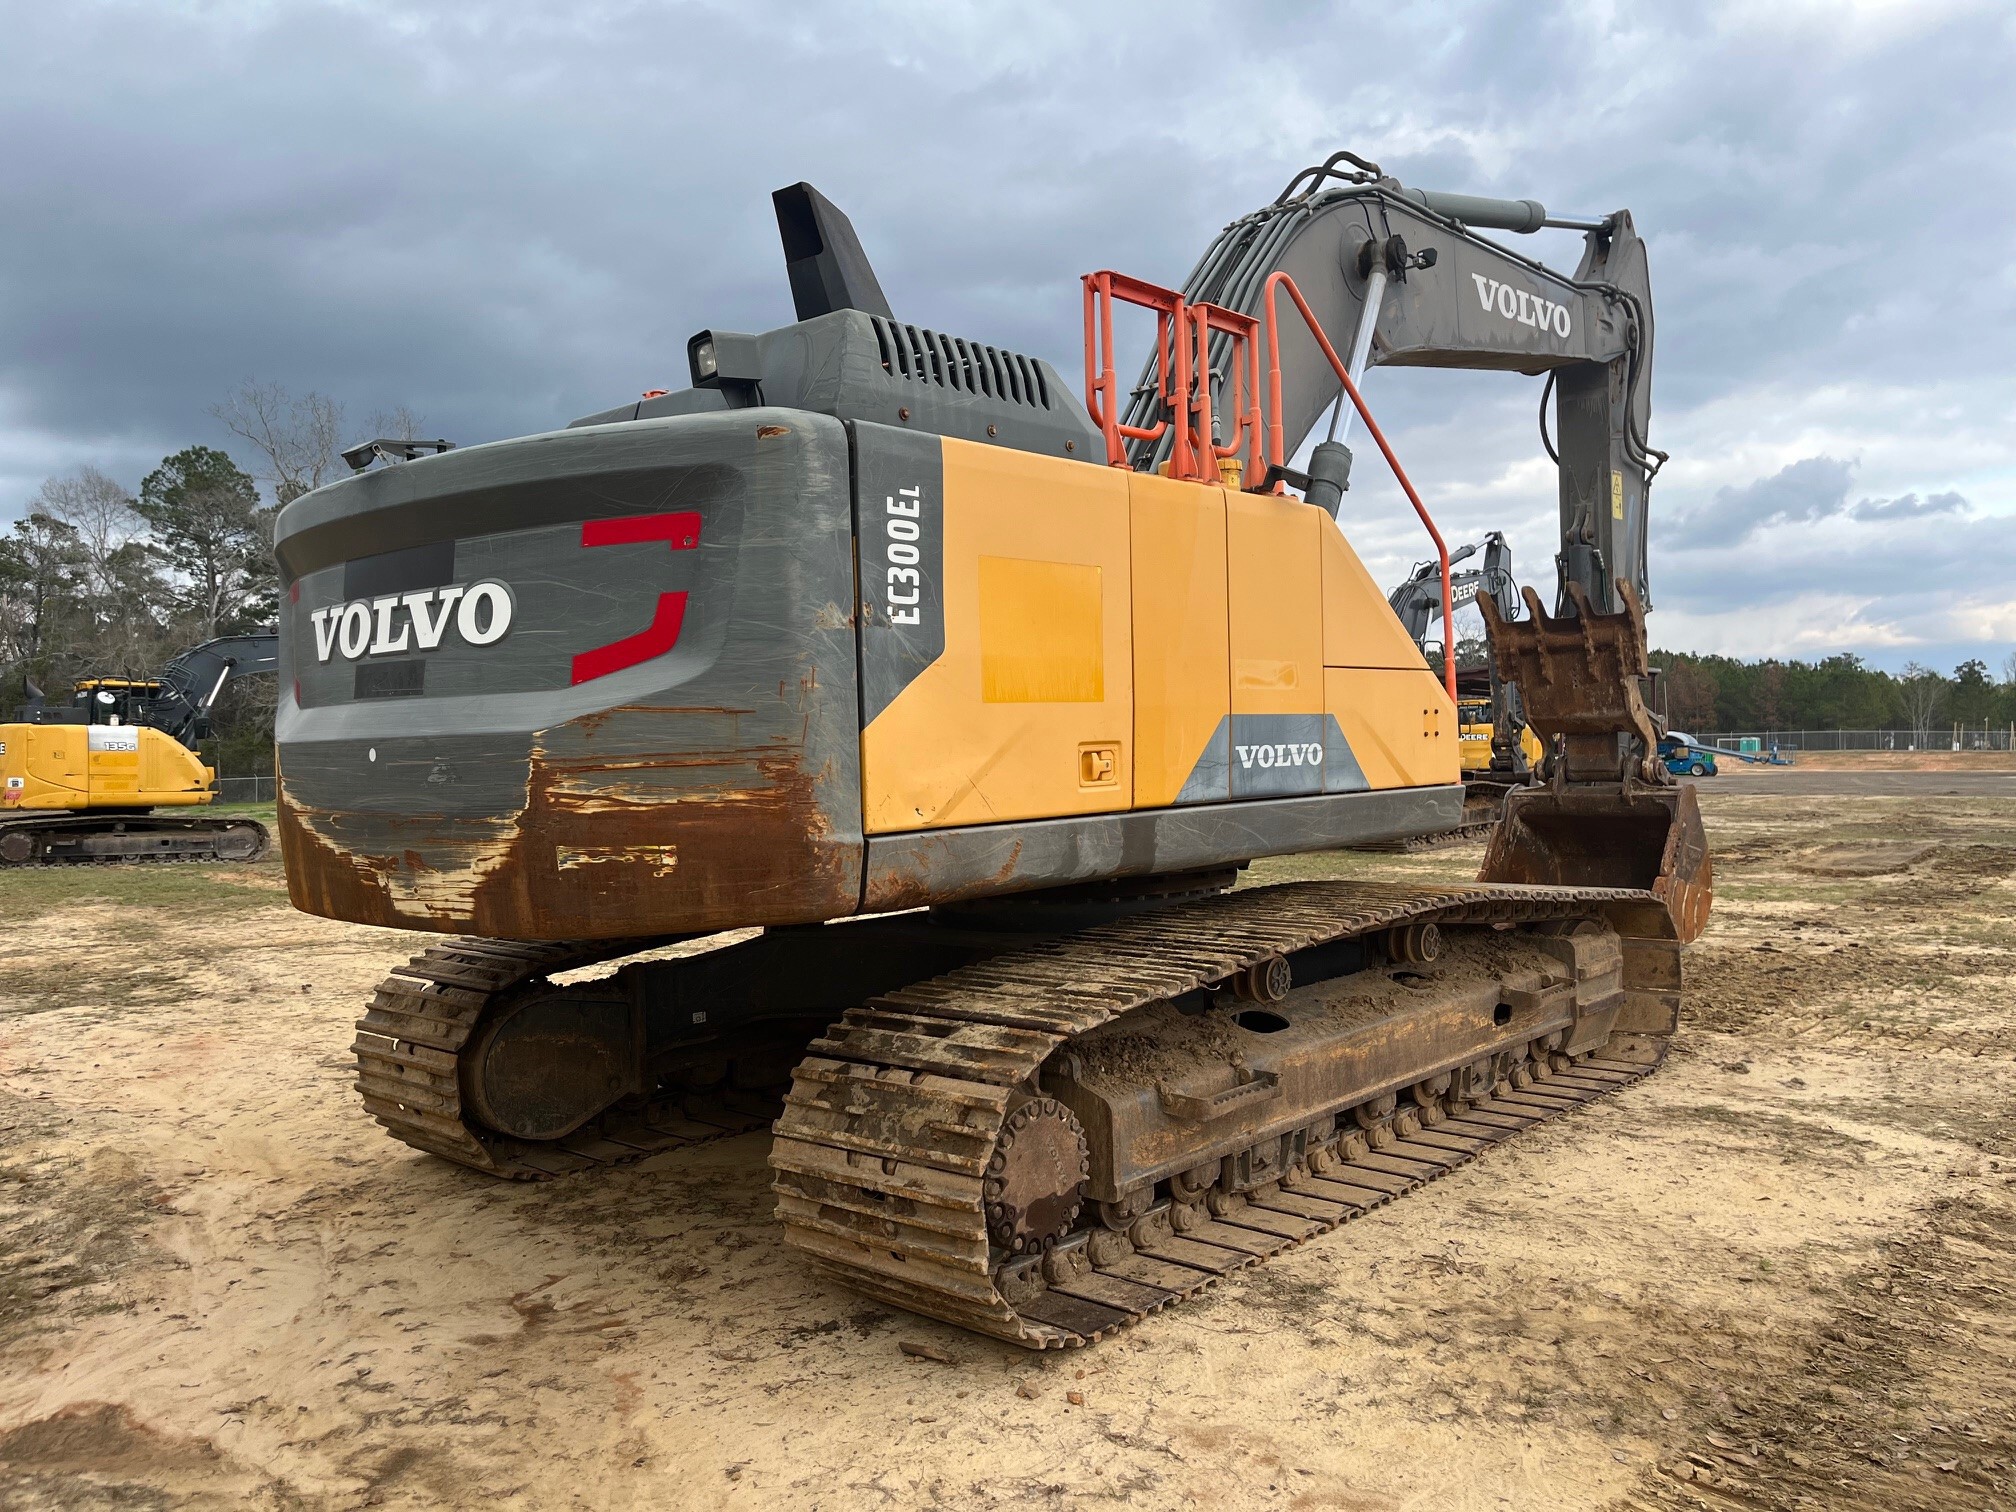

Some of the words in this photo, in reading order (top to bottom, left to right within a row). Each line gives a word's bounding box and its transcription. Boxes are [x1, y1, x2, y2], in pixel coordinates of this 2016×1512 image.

[1471, 272, 1571, 338] VOLVO
[886, 485, 920, 625] EC300EL
[311, 582, 512, 662] VOLVO
[104, 742, 135, 751] 135G
[1235, 742, 1323, 768] VOLVO
[1460, 733, 1488, 741] DEERE
